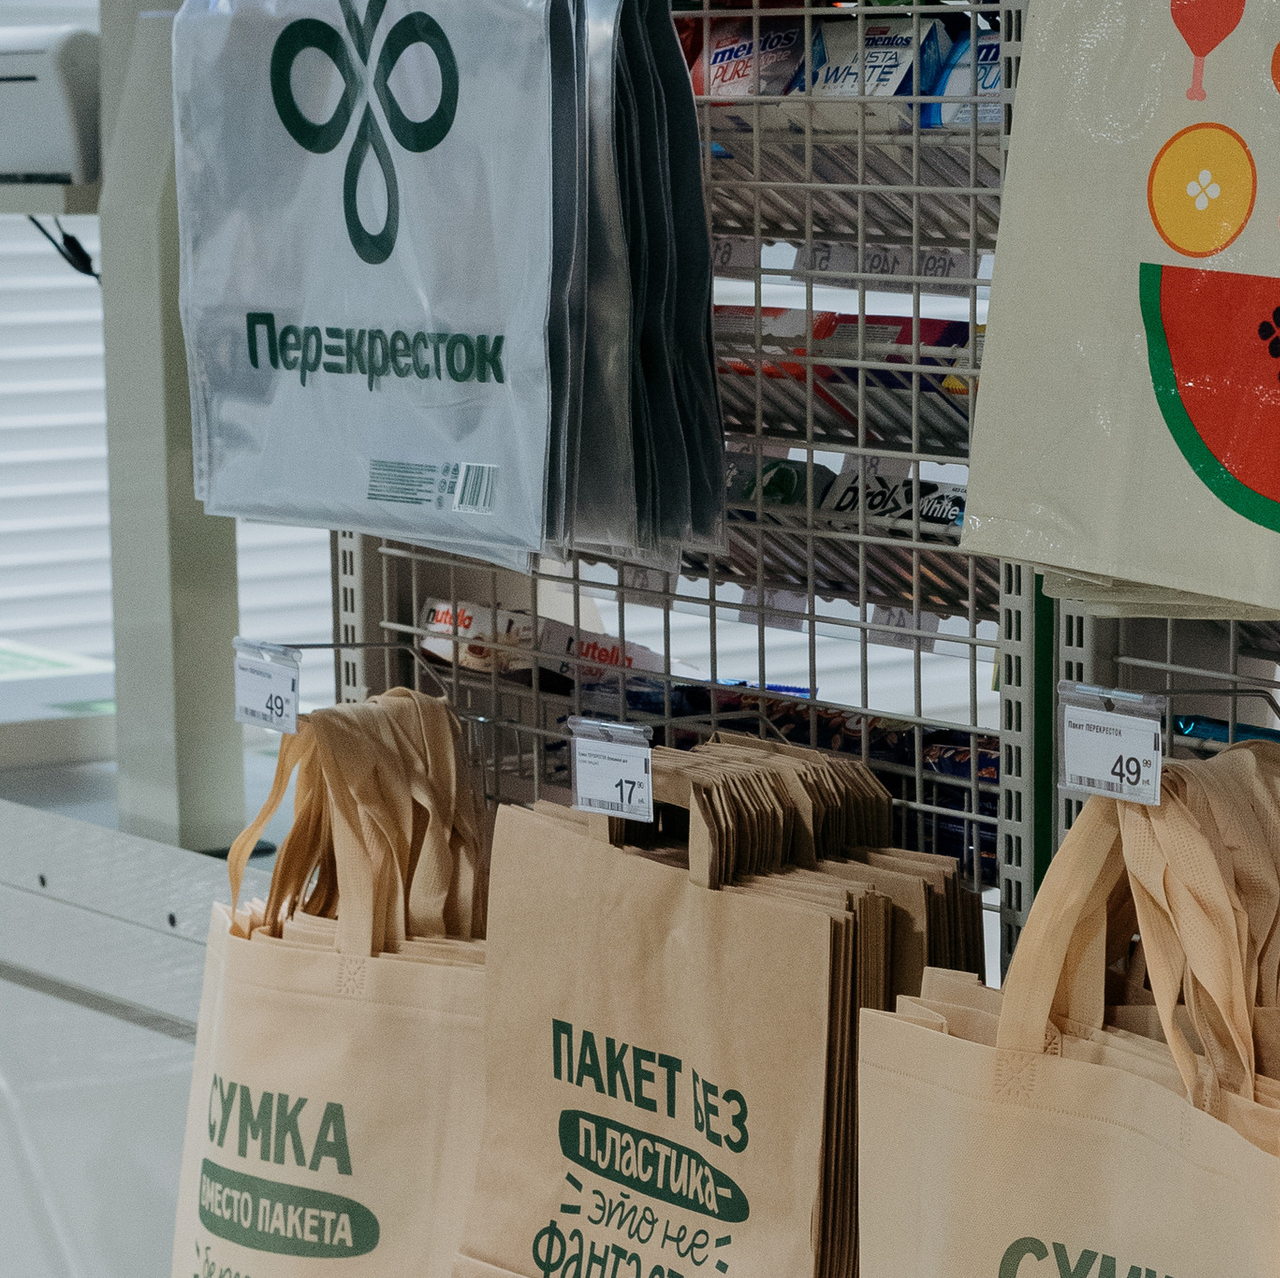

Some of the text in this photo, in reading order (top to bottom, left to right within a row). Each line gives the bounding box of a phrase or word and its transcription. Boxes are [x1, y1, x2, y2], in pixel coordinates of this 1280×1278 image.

[265, 693, 285, 718] 49
[614, 778, 637, 805] 17
[1110, 754, 1142, 786] 49
[552, 1018, 749, 1153] ПАКЕТ БЕЗ
[208, 1073, 353, 1176] СУМКА
[201, 1172, 354, 1247] ВМЕСТО ПАКЕТА
[587, 1188, 710, 1267] это не
